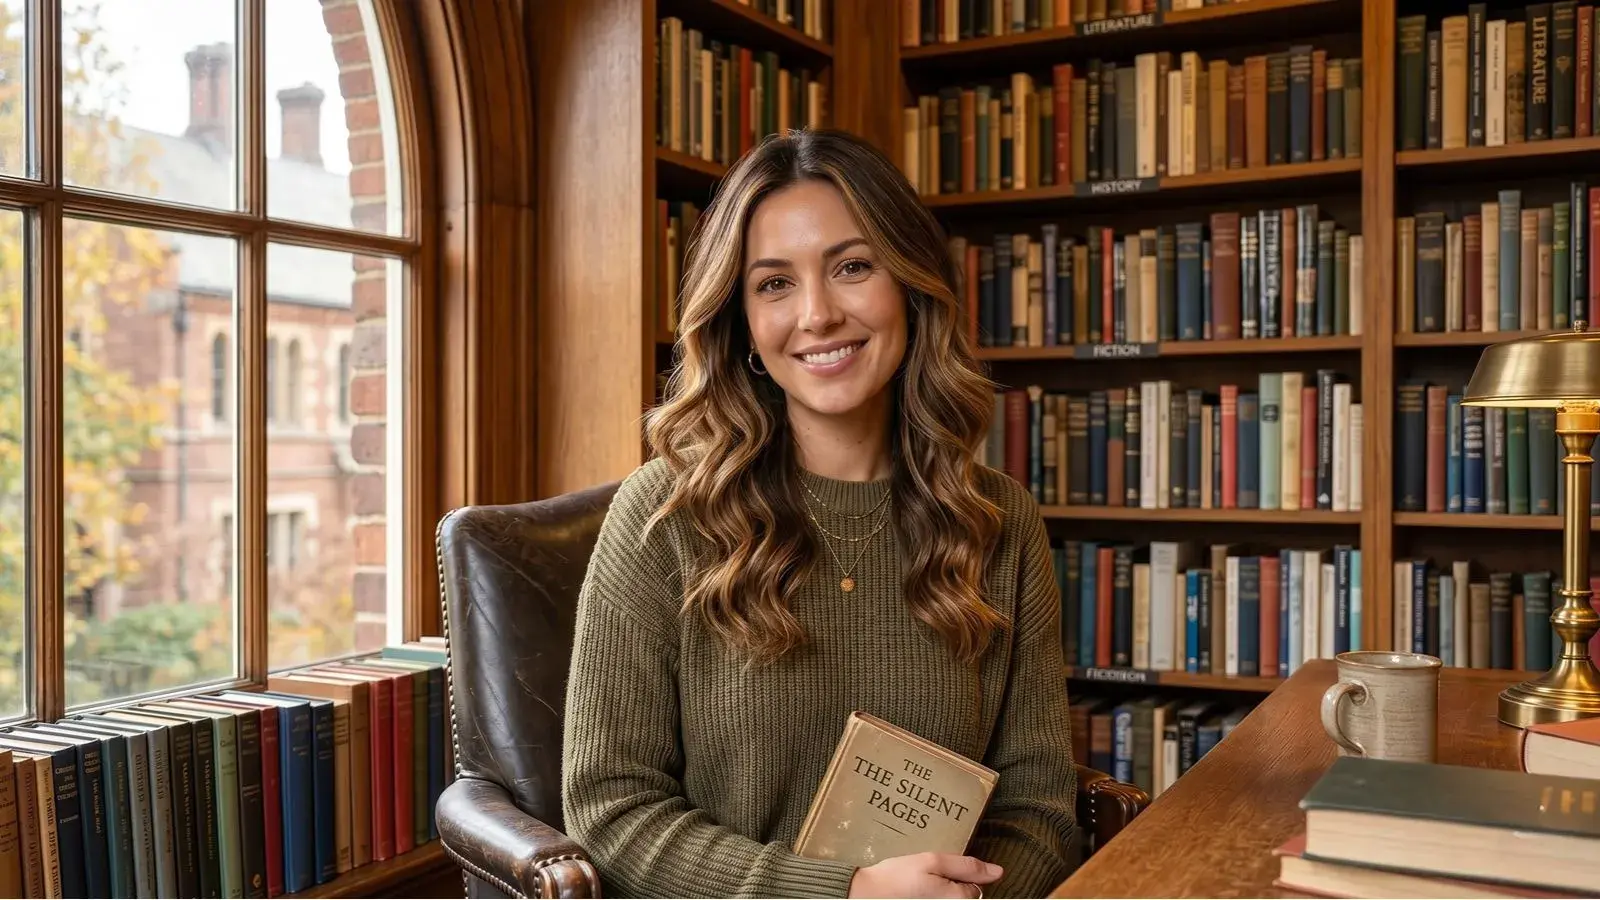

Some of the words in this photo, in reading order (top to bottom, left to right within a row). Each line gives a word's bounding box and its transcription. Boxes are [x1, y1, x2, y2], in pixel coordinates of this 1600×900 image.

[1083, 14, 1155, 35] LITERATURE
[1532, 16, 1548, 105] LITERATURE
[1091, 180, 1142, 194] HISTORY
[1093, 344, 1141, 358] FICTION
[903, 758, 933, 781] THE
[853, 756, 894, 787] THE
[896, 779, 969, 822] SILENT
[867, 790, 931, 830] PAGES
